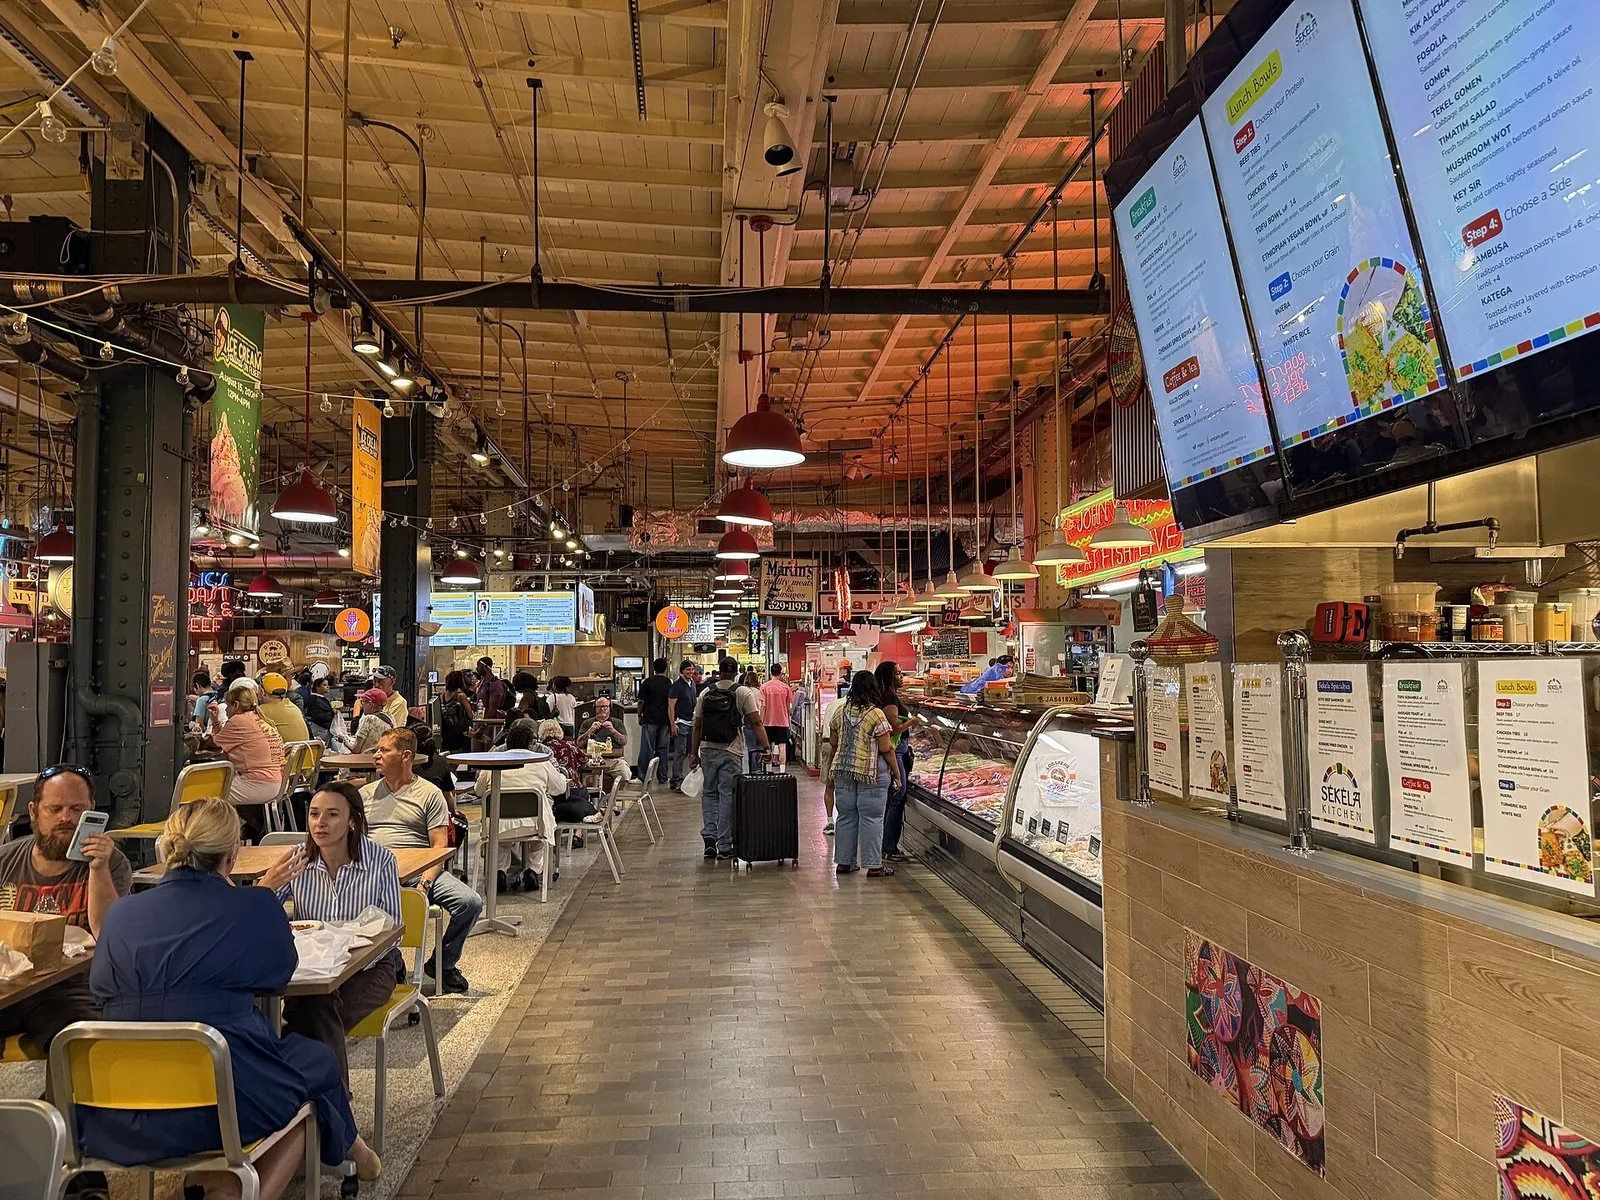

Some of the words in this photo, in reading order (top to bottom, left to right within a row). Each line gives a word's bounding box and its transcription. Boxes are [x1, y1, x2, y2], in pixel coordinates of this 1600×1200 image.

[1409, 20, 1421, 36] KIK
[1422, 0, 1450, 25] ALICHA
[1458, 25, 1475, 43] beans
[1475, 13, 1487, 28] and
[1416, 33, 1448, 64] FOSOLIA
[1427, 82, 1446, 102] Collard
[1446, 69, 1465, 89] greens
[1488, 39, 1503, 54] with
[1503, 24, 1522, 44] garlic
[1522, 12, 1535, 28] and
[1228, 87, 1253, 118] Lunch
[1252, 61, 1278, 93] Bowls
[1424, 64, 1450, 91] GOMEN
[1434, 109, 1457, 130] Cabbage
[1458, 99, 1469, 112] and
[1469, 85, 1490, 104] carrots
[1490, 80, 1497, 89] in
[1497, 76, 1502, 84] a
[1501, 38, 1551, 80] turmeric-ginger
[1552, 23, 1574, 43] sauce
[1235, 134, 1247, 149] Step
[1247, 127, 1253, 138] 1:
[1255, 107, 1274, 129] Choose
[1273, 96, 1286, 114] your
[1285, 77, 1305, 100] Protein
[1431, 98, 1453, 118] TEKEL
[1454, 74, 1482, 101] GOMEN
[1441, 142, 1457, 158] Fresh
[1524, 80, 1546, 99] lemon
[1546, 75, 1553, 84] &
[1553, 64, 1571, 80] olive
[1571, 54, 1582, 67] oil
[1438, 119, 1469, 146] TIMATIM
[1470, 99, 1497, 124] SALAD
[1471, 145, 1506, 171] mushrooms
[1505, 140, 1512, 149] in
[1512, 124, 1537, 144] berbere
[1537, 113, 1551, 128] and
[1551, 102, 1571, 119] onion
[1571, 87, 1593, 106] sauce
[1239, 152, 1251, 168] BEEF
[1250, 142, 1261, 157] TIBS
[1264, 133, 1270, 144] 17
[1445, 139, 1491, 174] MUSHROOM
[1491, 123, 1512, 143] WOT
[1247, 180, 1267, 201] CHICKEN
[1266, 170, 1278, 184] TIBS
[1281, 161, 1289, 172] 16
[1453, 187, 1467, 202] KEY
[1468, 178, 1482, 194] SIR
[1456, 200, 1473, 214] Beets
[1472, 193, 1484, 204] and
[1484, 181, 1507, 197] carrots,
[1506, 167, 1526, 184] lightly
[1526, 146, 1558, 171] seasoned
[1255, 221, 1267, 235] TOFU
[1267, 210, 1283, 226] BOWL
[1290, 197, 1297, 208] 14
[1466, 225, 1487, 243] Step
[1488, 217, 1499, 230] 4:
[1503, 197, 1540, 221] Choose
[1541, 191, 1548, 202] a
[1548, 177, 1573, 197] Side
[1262, 238, 1287, 262] ETHIOPIAN
[1286, 225, 1305, 243] VEGAN
[1304, 214, 1322, 231] BOWL
[1471, 240, 1510, 267] SAMBUSA
[1504, 247, 1534, 266] Ethiopian
[1533, 236, 1557, 253] pastry:
[1556, 225, 1573, 239] beef
[1271, 283, 1283, 296] Step
[1283, 277, 1290, 288] 2:
[1291, 264, 1311, 282] Choose
[1311, 256, 1324, 271] your
[1323, 244, 1340, 260] Grain
[1477, 279, 1493, 291] lentil
[1493, 274, 1501, 283] +4
[1274, 301, 1292, 316] INJERA
[1480, 285, 1512, 306] KATEGA
[1485, 304, 1508, 320] Toasted
[1508, 295, 1525, 311] injera
[1525, 285, 1549, 303] layered
[1549, 278, 1565, 292] with
[1565, 264, 1597, 284] Ethiopian
[1488, 321, 1500, 331] and
[1499, 311, 1522, 327] berbere
[1523, 305, 1532, 316] +5
[227, 333, 238, 356] ICE
[238, 342, 262, 372] CREAM
[1282, 333, 1299, 347] WHITE
[1298, 327, 1310, 339] RICE
[219, 371, 238, 391] August
[1165, 371, 1181, 388] Coffee
[1181, 366, 1187, 377] &
[1187, 362, 1198, 374] Tea
[1078, 503, 1109, 532] JOHN
[1139, 522, 1179, 558] LVE
[188, 586, 229, 602] OAST
[791, 579, 813, 587] meats
[188, 617, 223, 633] EEF
[1497, 683, 1515, 691] Lunch
[1516, 682, 1534, 691] Bowls
[1321, 804, 1362, 823] KITCHEN
